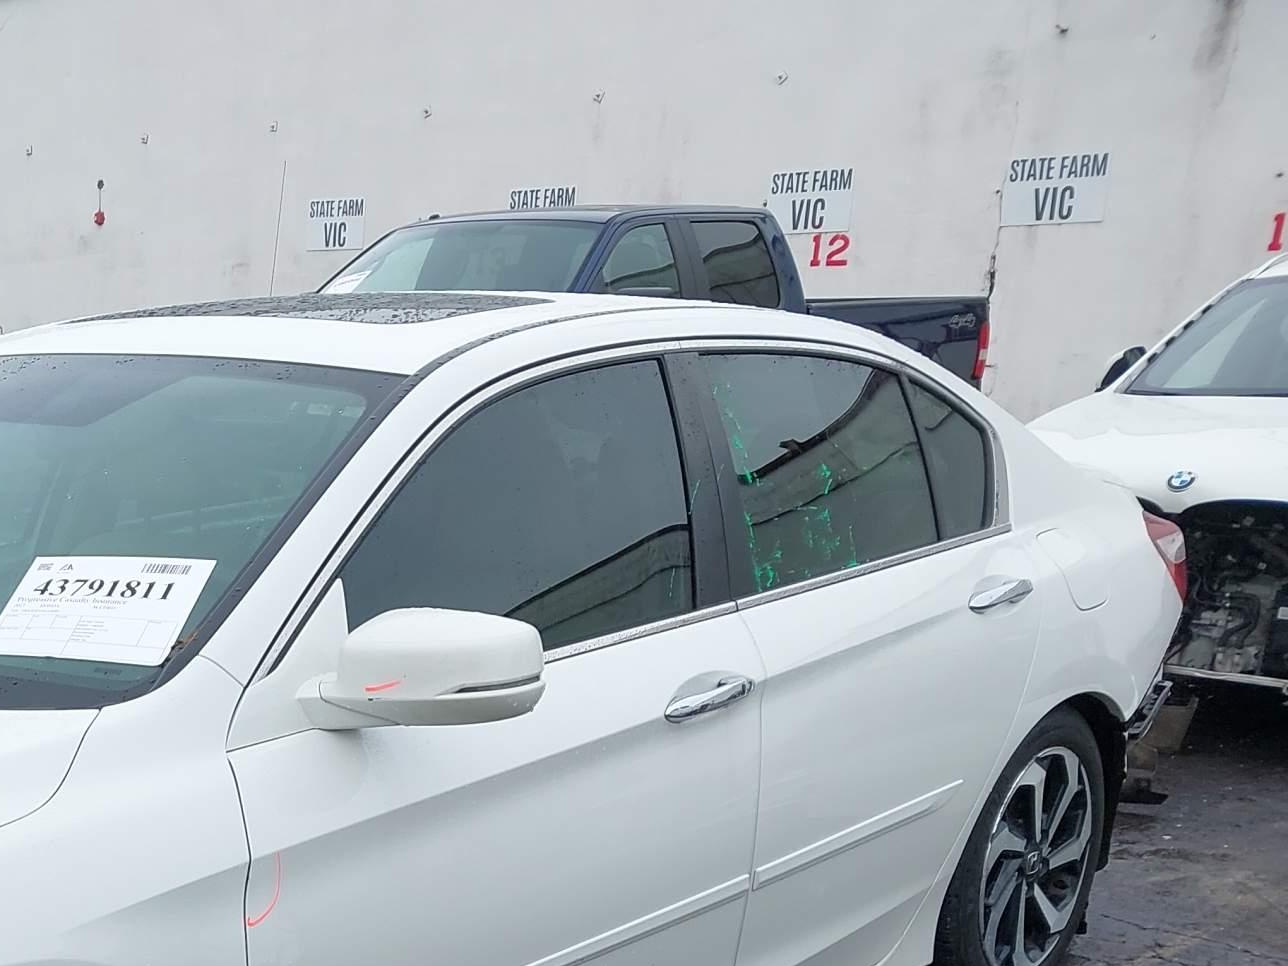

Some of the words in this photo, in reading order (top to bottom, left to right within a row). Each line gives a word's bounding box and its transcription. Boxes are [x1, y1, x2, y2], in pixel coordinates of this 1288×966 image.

[771, 171, 809, 195] STATE
[811, 168, 853, 192] FARM
[1008, 157, 1056, 183] STATE
[1060, 153, 1109, 179] FARM
[309, 200, 336, 218] STATE
[337, 199, 364, 217] FARM
[510, 188, 541, 210] STATE
[543, 186, 576, 208] FARM
[1033, 185, 1075, 222] VIC
[791, 198, 826, 231] VIC
[324, 221, 347, 248] VIC
[809, 233, 852, 268] 12
[33, 578, 176, 600] 43791811
